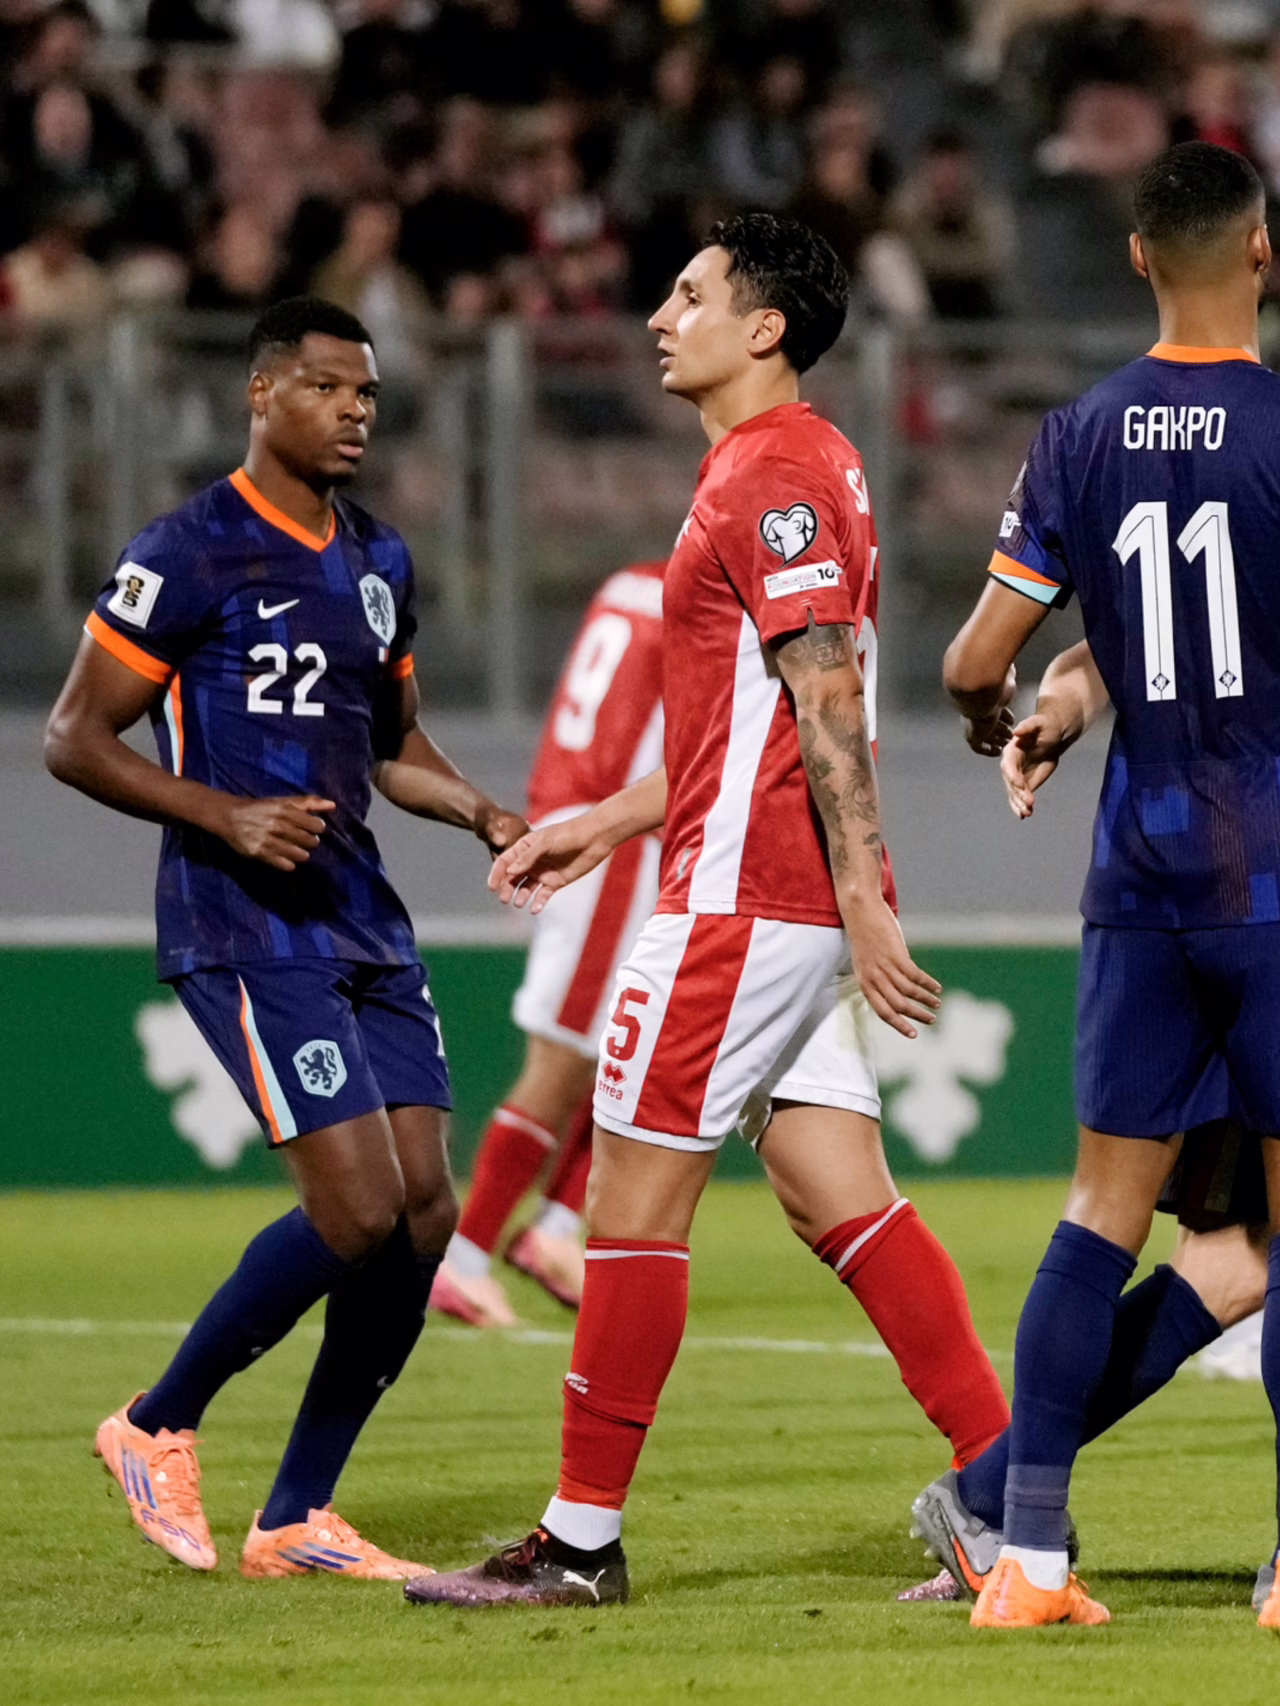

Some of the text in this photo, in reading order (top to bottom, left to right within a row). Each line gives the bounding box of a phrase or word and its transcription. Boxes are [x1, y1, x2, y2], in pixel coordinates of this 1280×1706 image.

[1123, 405, 1227, 451] GAKPO
[1112, 501, 1244, 702] 11
[247, 643, 328, 717] 22
[553, 612, 633, 752] 9
[607, 987, 650, 1061] 5
[599, 1080, 624, 1101] errea
[140, 1508, 201, 1551] F50
